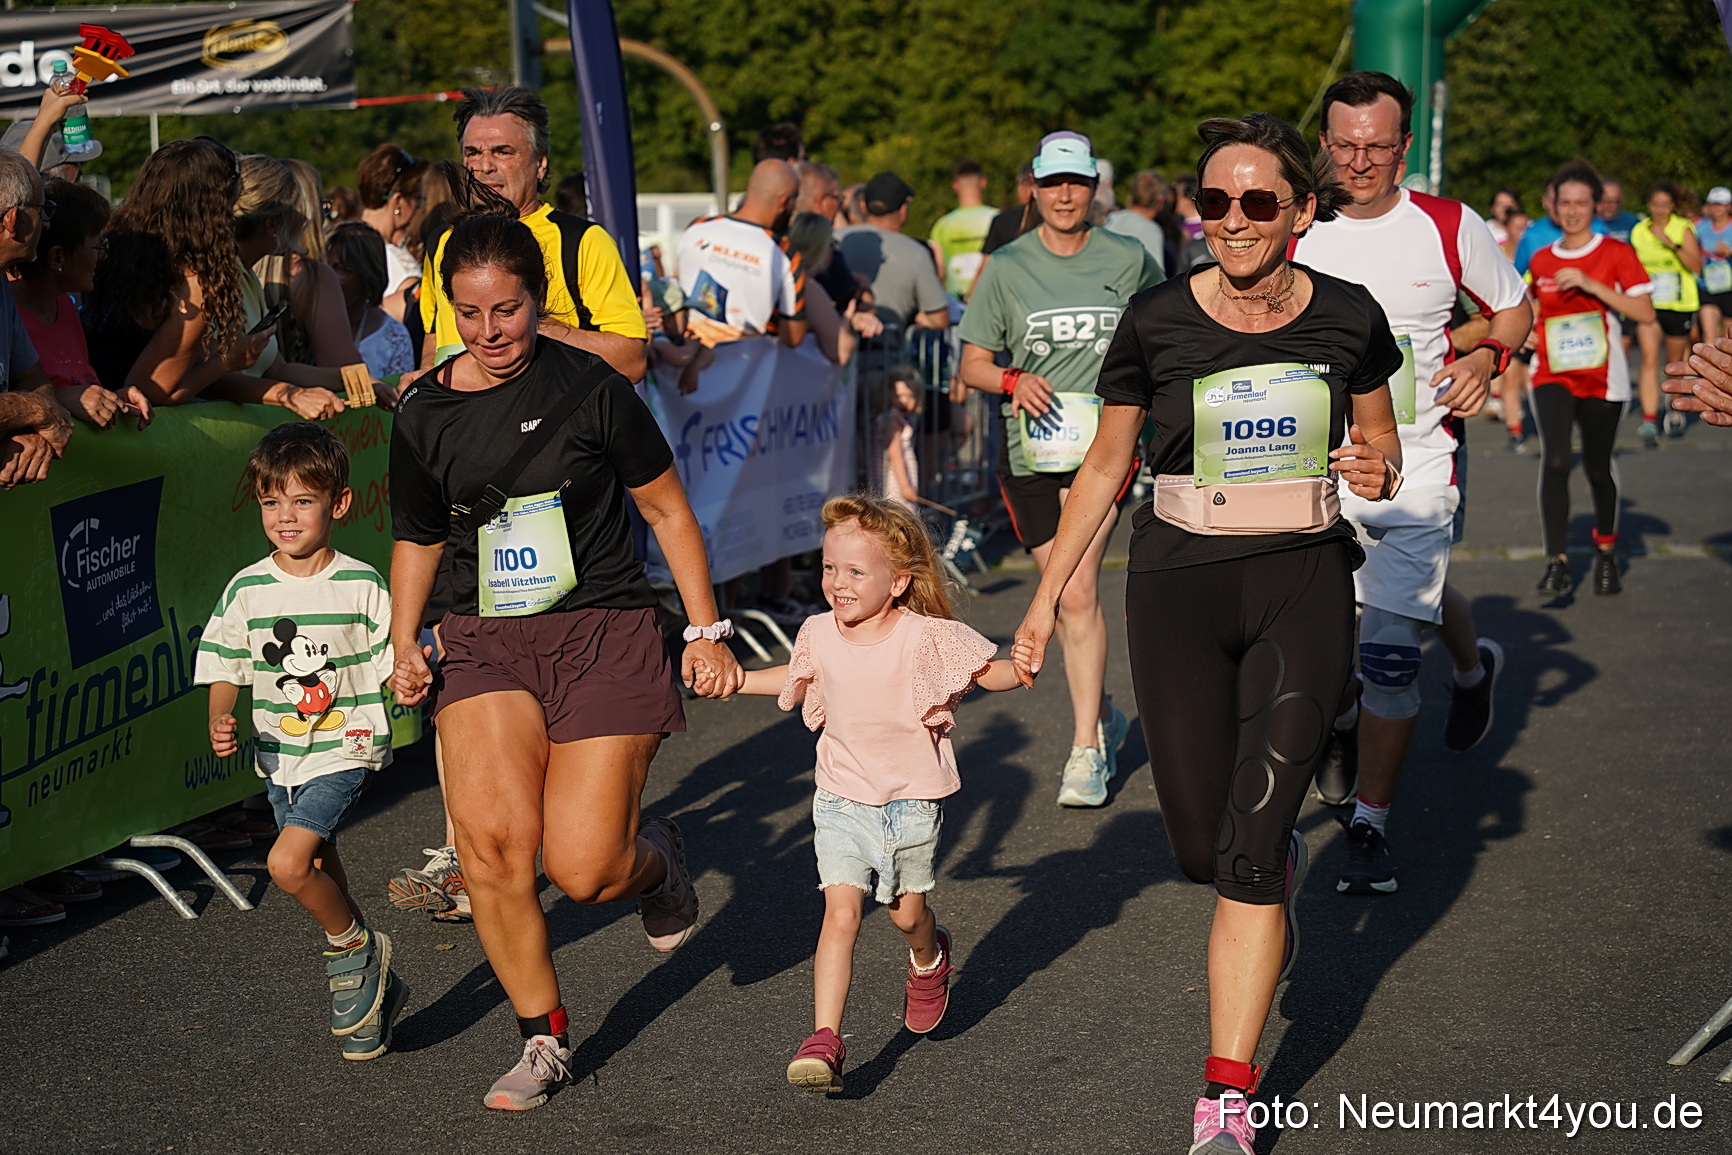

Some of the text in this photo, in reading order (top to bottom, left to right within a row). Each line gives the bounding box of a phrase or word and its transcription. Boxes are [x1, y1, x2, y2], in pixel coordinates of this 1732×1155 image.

[171, 79, 195, 95] Ein
[225, 78, 250, 94] der
[251, 76, 328, 93] verbindet.
[1052, 313, 1096, 341] B2
[402, 387, 418, 404] JAKO
[1227, 390, 1267, 401] Firmenlauf
[700, 399, 838, 472] FRISCHMANN
[1222, 416, 1297, 441] 1096
[1225, 443, 1296, 455] Joanna Lang
[75, 534, 141, 578] Fischer
[493, 546, 538, 571] 1100
[86, 560, 136, 592] AUTOMOBILE
[488, 575, 557, 588] Isabell Vitzthum
[28, 726, 132, 808] neumarkt
